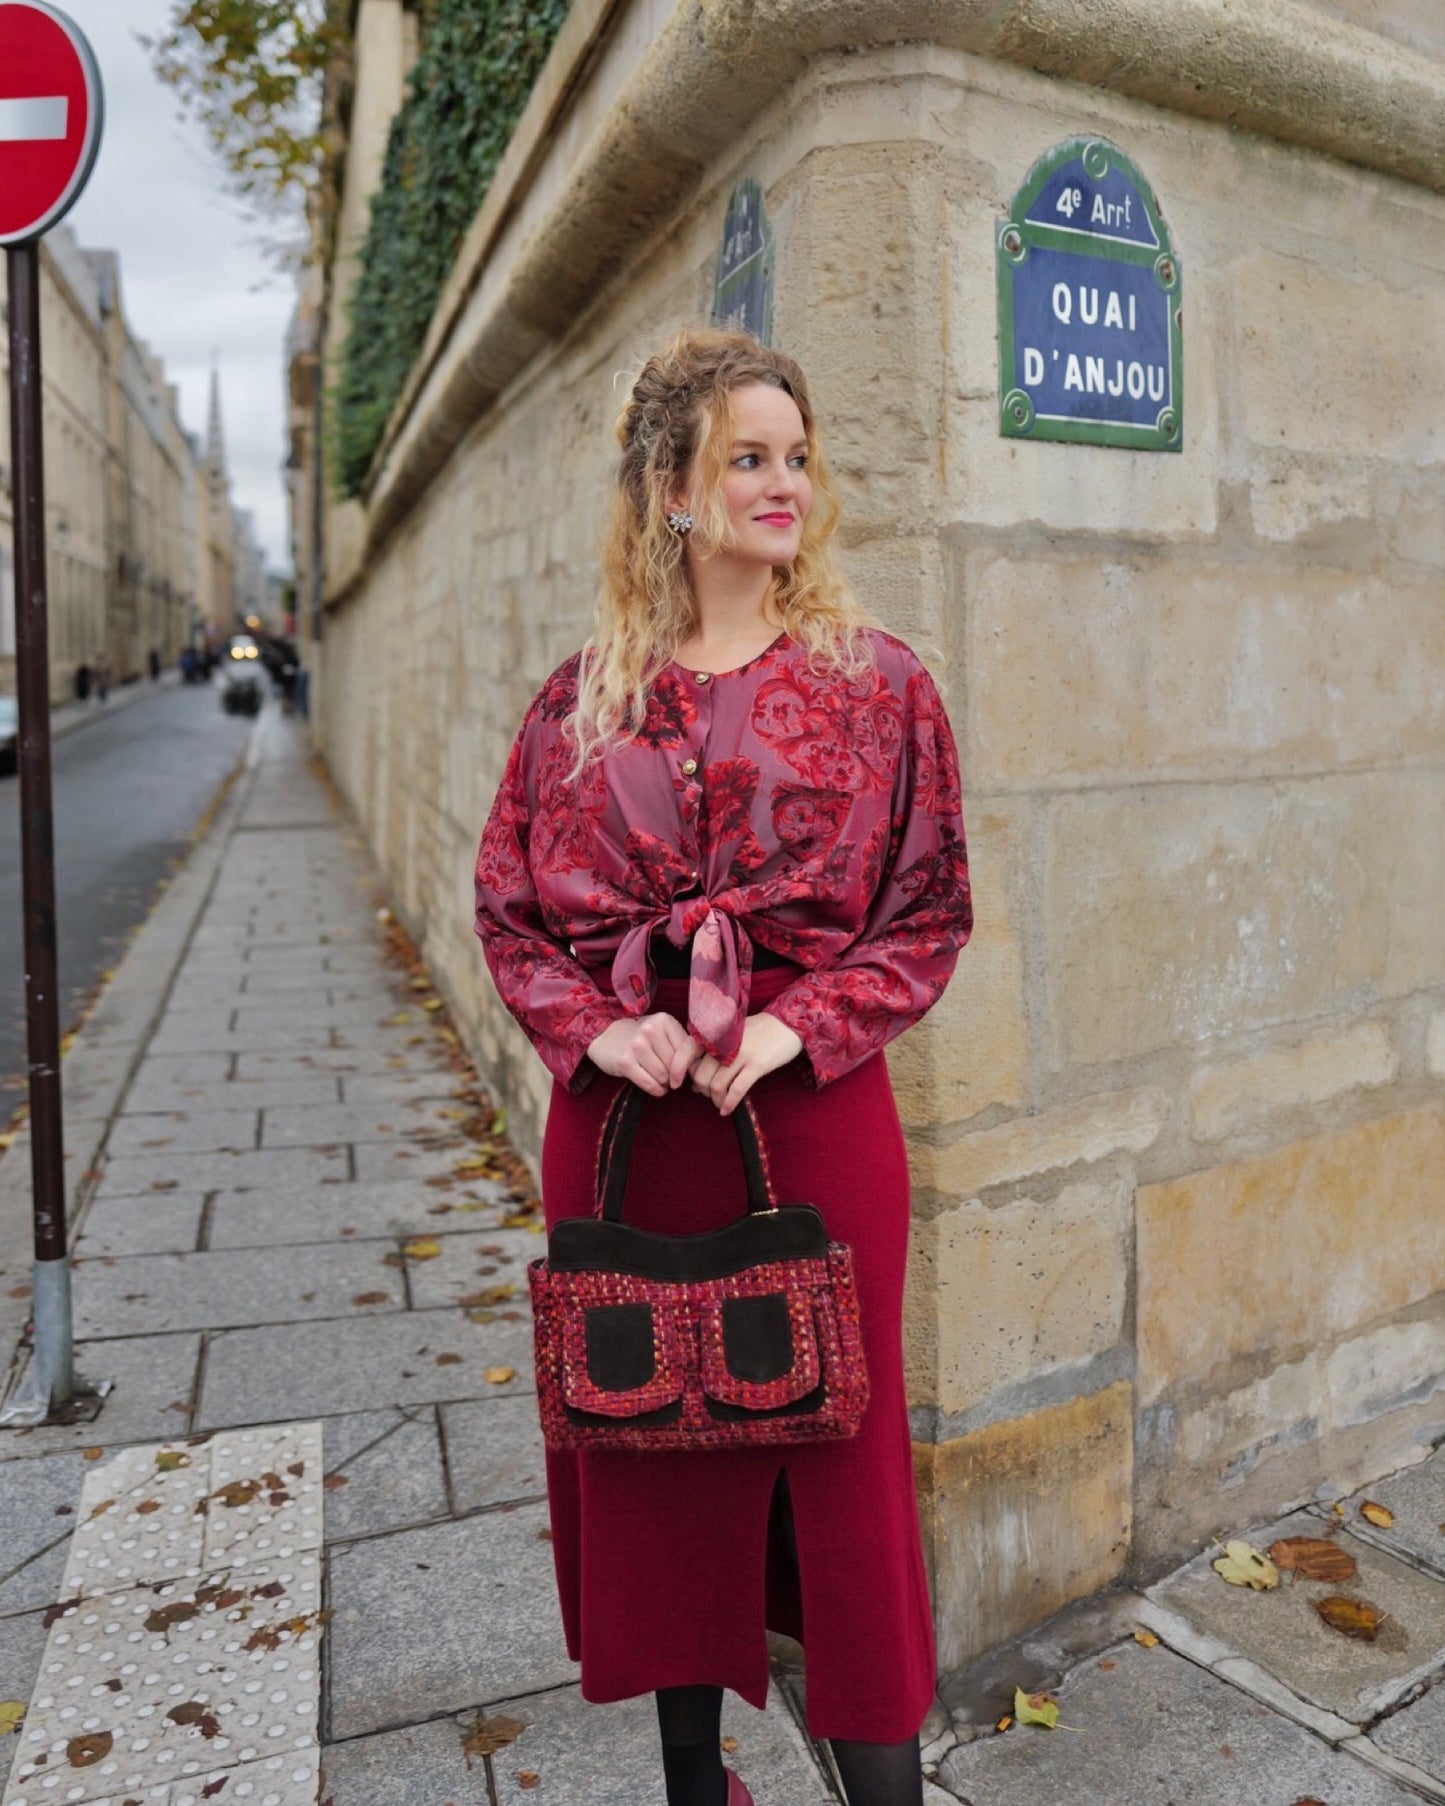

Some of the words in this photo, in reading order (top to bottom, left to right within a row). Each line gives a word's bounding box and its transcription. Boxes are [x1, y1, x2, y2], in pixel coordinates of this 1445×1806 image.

[1056, 187, 1082, 218] 4e
[1052, 282, 1136, 331] QUAI
[1024, 347, 1164, 401] D'ANJOU
